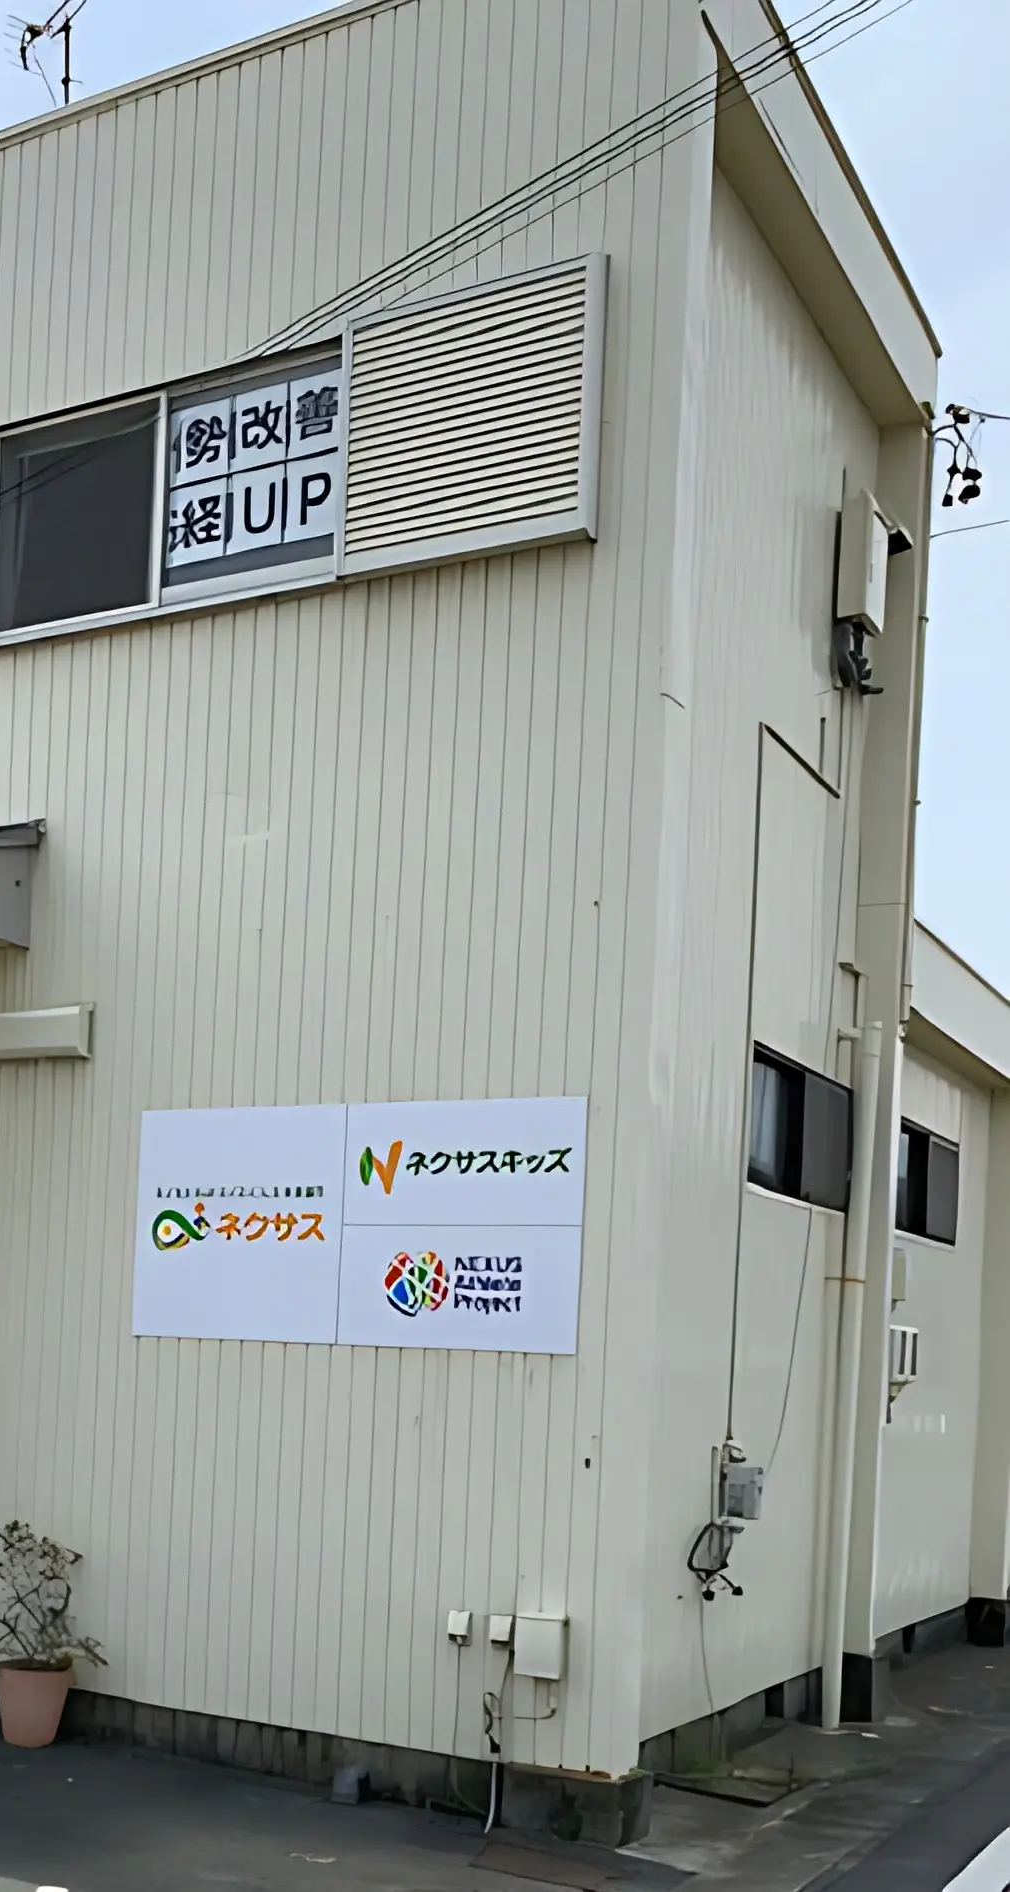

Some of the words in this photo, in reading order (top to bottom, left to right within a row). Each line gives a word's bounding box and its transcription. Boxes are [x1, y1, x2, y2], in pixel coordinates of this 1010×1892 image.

[406, 1147, 573, 1176] ネクサスキッズ
[215, 1212, 326, 1242] ネクサス
